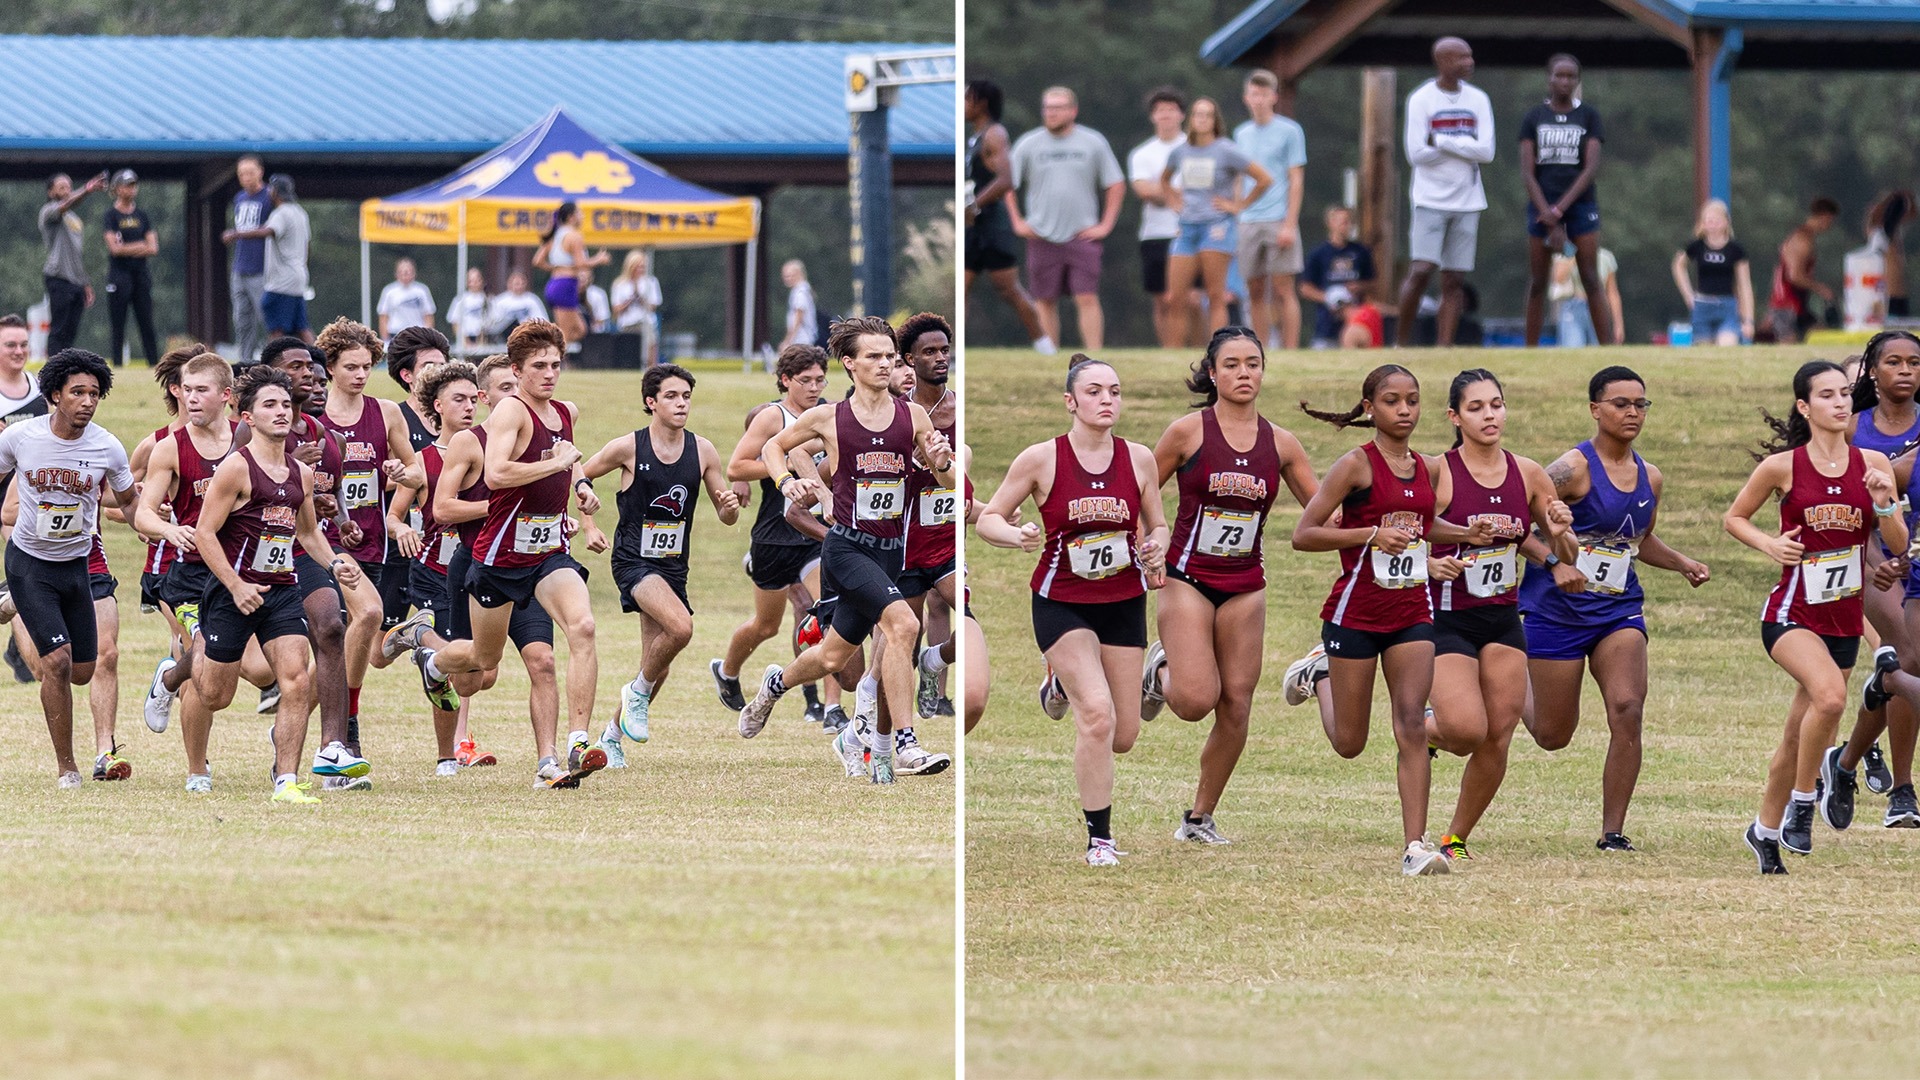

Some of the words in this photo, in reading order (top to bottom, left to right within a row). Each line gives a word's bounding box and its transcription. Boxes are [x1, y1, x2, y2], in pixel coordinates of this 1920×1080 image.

[856, 452, 905, 471] LOYOLA
[25, 468, 93, 490] LOYOLA
[1209, 472, 1267, 498] LOYOLA
[346, 483, 368, 499] 96
[870, 493, 894, 510] 88
[933, 498, 954, 515] 82
[1069, 497, 1130, 520] LOYOLA
[51, 515, 73, 530] 97
[1804, 504, 1863, 528] LOYOLA
[529, 527, 550, 543] 93
[650, 533, 677, 549] 193
[1218, 526, 1244, 546] 73
[268, 547, 286, 565] 95
[1089, 546, 1113, 569] 76
[1388, 556, 1413, 577] 80
[1482, 562, 1504, 585] 78
[1595, 562, 1611, 582] 5
[1825, 565, 1848, 589] 77
